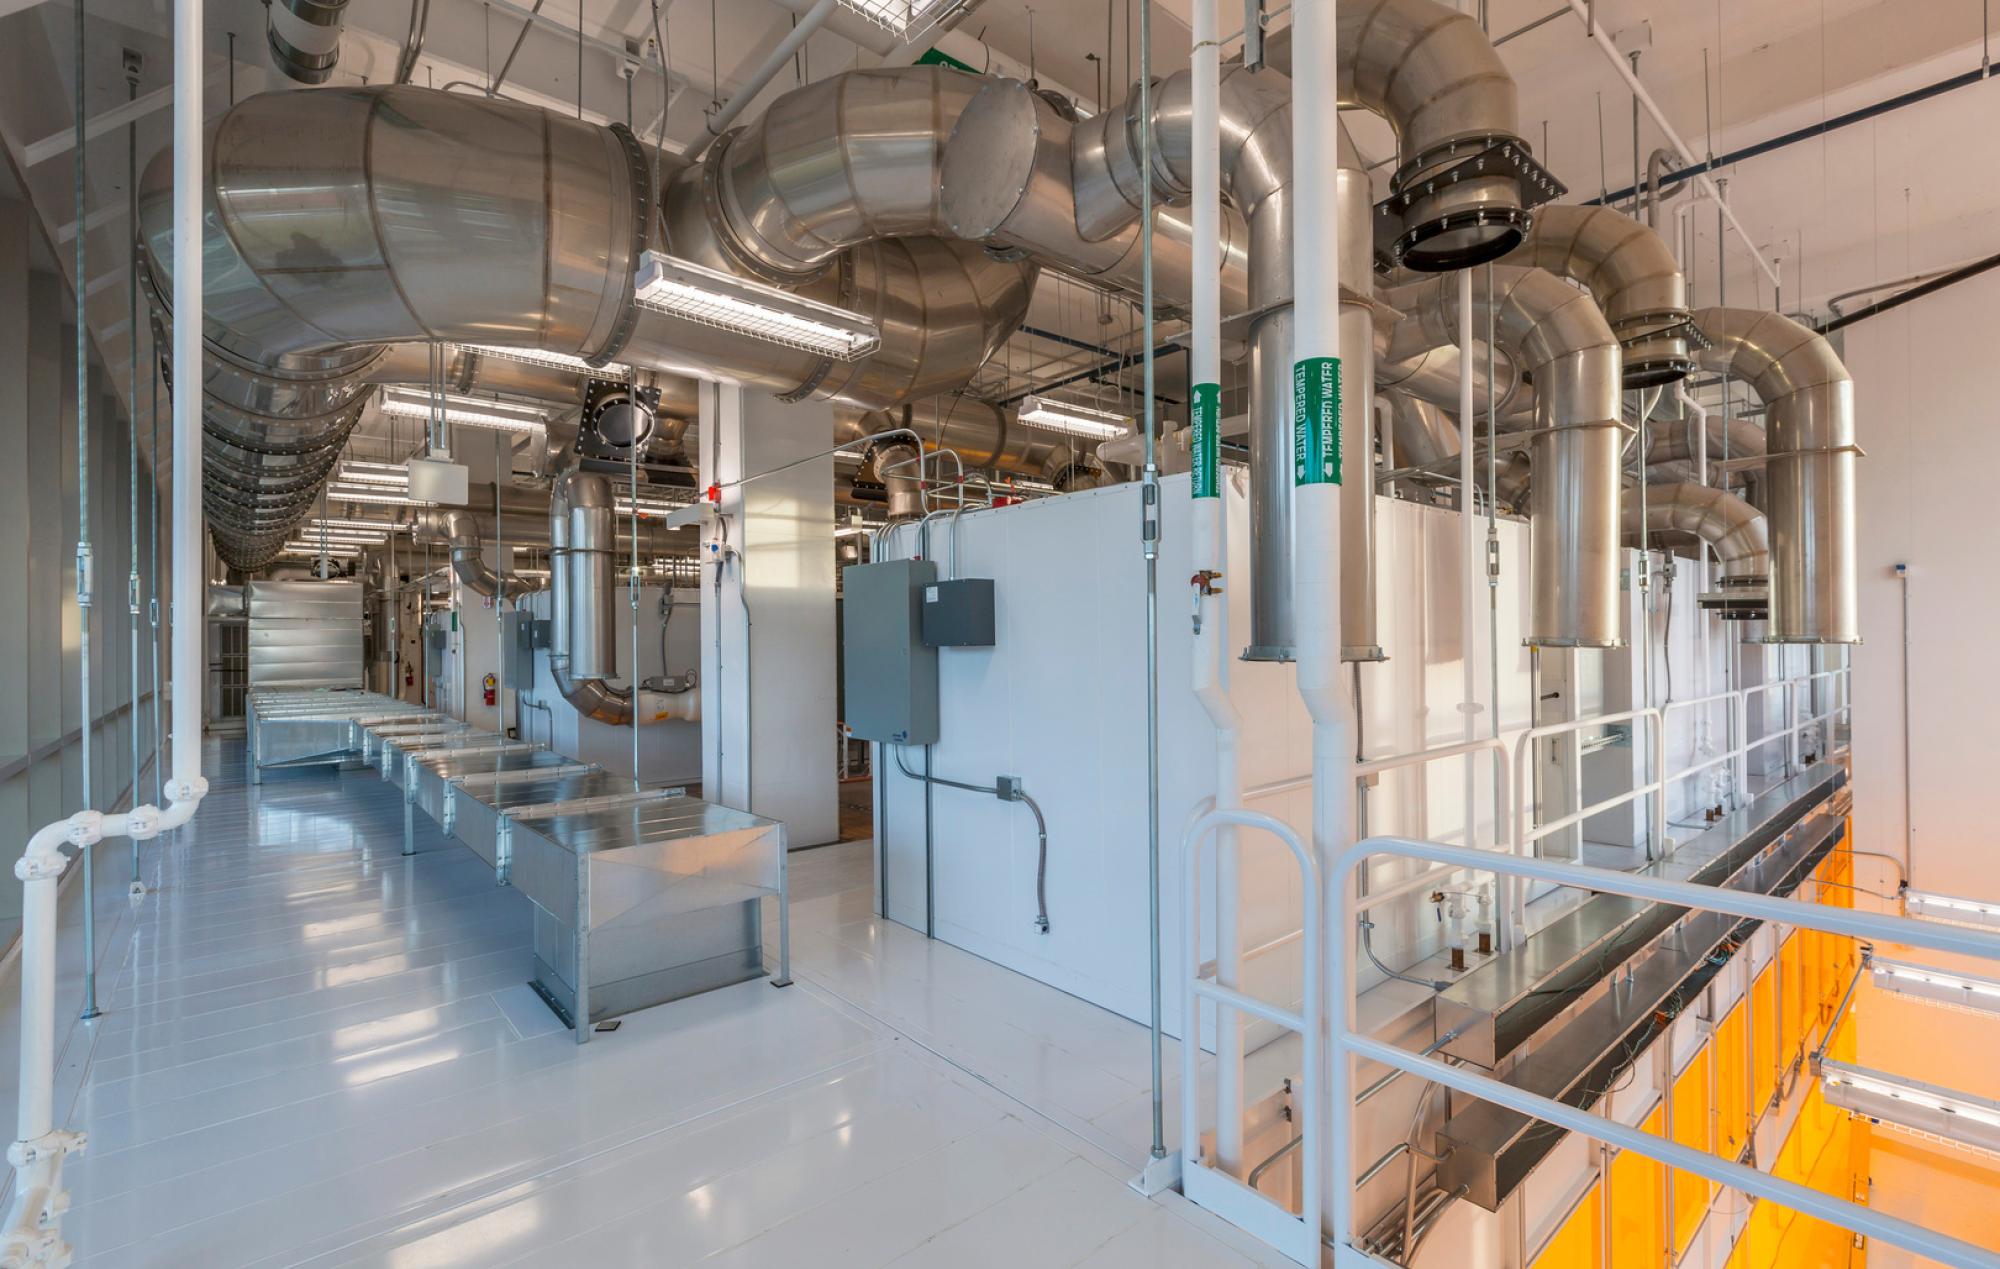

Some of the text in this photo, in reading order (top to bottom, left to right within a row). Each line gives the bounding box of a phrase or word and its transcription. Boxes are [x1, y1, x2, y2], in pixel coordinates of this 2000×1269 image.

[1192, 406, 1202, 442] TEMPERED
[1295, 365, 1306, 462] TEMPERED WATER
[1321, 361, 1333, 457] TEMPERED WATER
[1192, 442, 1202, 466] WATER
